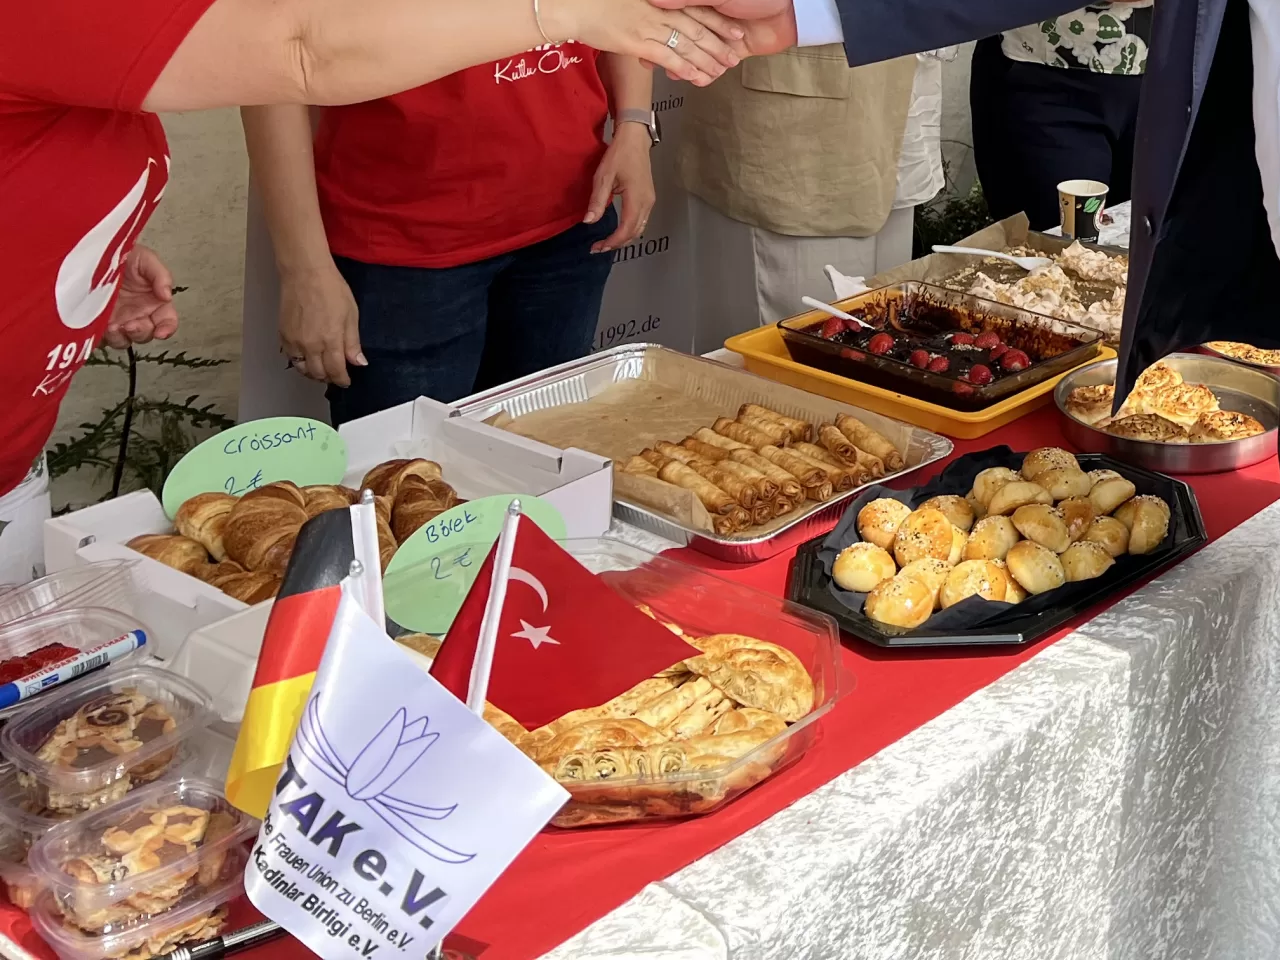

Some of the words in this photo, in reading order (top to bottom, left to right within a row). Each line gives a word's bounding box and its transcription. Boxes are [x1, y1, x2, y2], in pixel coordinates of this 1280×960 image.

[494, 59, 537, 84] Kutlu
[224, 476, 243, 495] 2
[246, 469, 263, 490] €
[430, 556, 451, 580] 2
[453, 547, 474, 569] €
[270, 832, 309, 874] Frauen
[307, 863, 338, 897] Union
[336, 886, 356, 907] zu
[353, 898, 389, 935] Berlin
[386, 927, 414, 952] e.V.
[352, 848, 448, 930] e.V.
[301, 893, 352, 938] Birligi
[347, 933, 380, 960] e.V.
